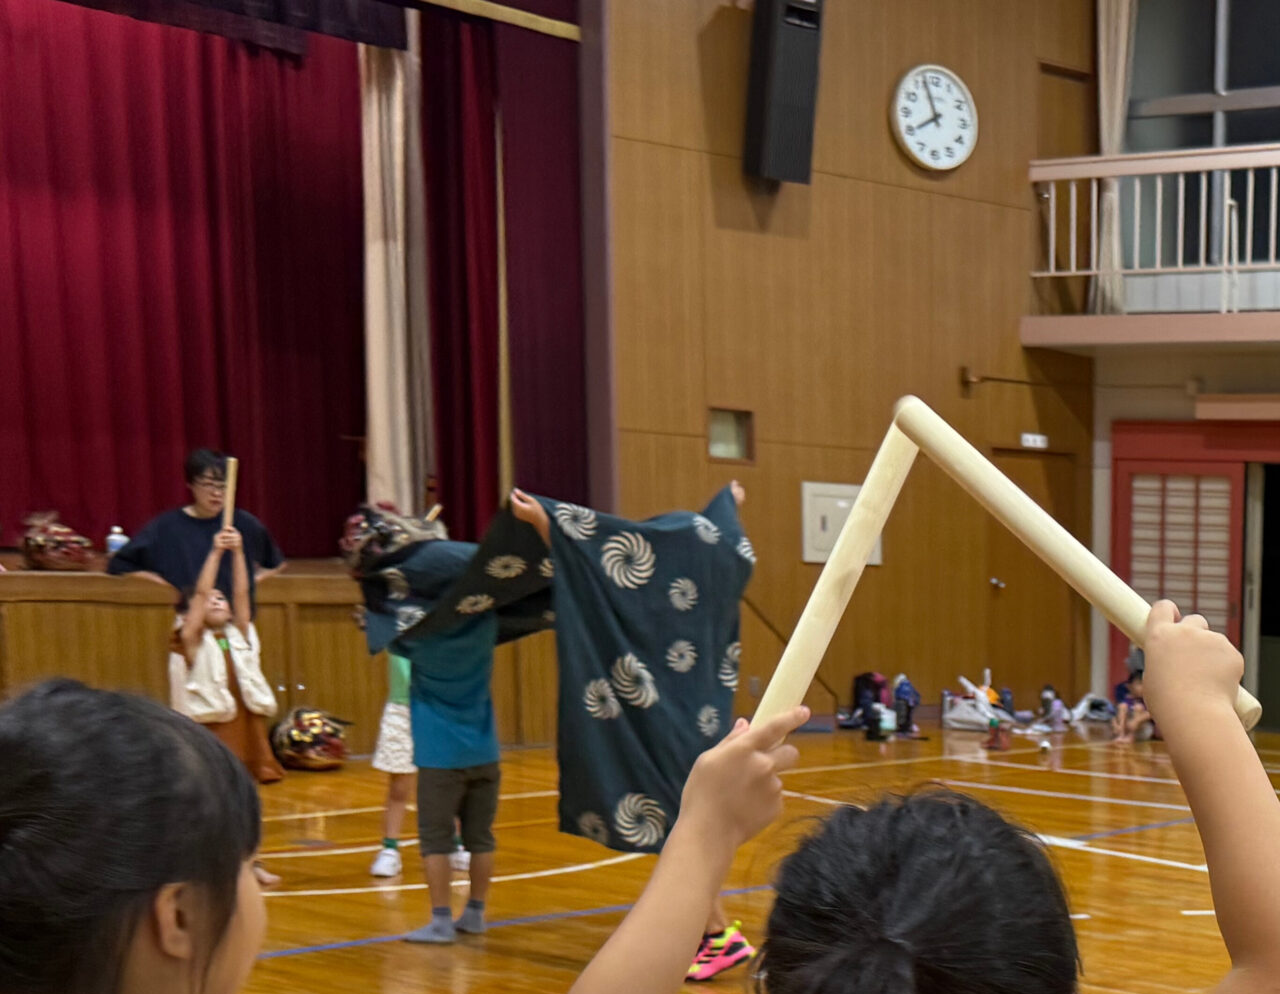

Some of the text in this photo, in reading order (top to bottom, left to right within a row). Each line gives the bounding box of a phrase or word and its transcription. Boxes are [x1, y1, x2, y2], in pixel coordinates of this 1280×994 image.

[929, 75, 942, 88] 12
[954, 99, 966, 111] 2
[901, 106, 912, 118] 9
[958, 118, 969, 130] 3
[905, 125, 915, 136] 8
[954, 134, 964, 145] 4
[916, 141, 926, 152] 7
[944, 146, 955, 158] 5
[930, 149, 941, 160] 6
